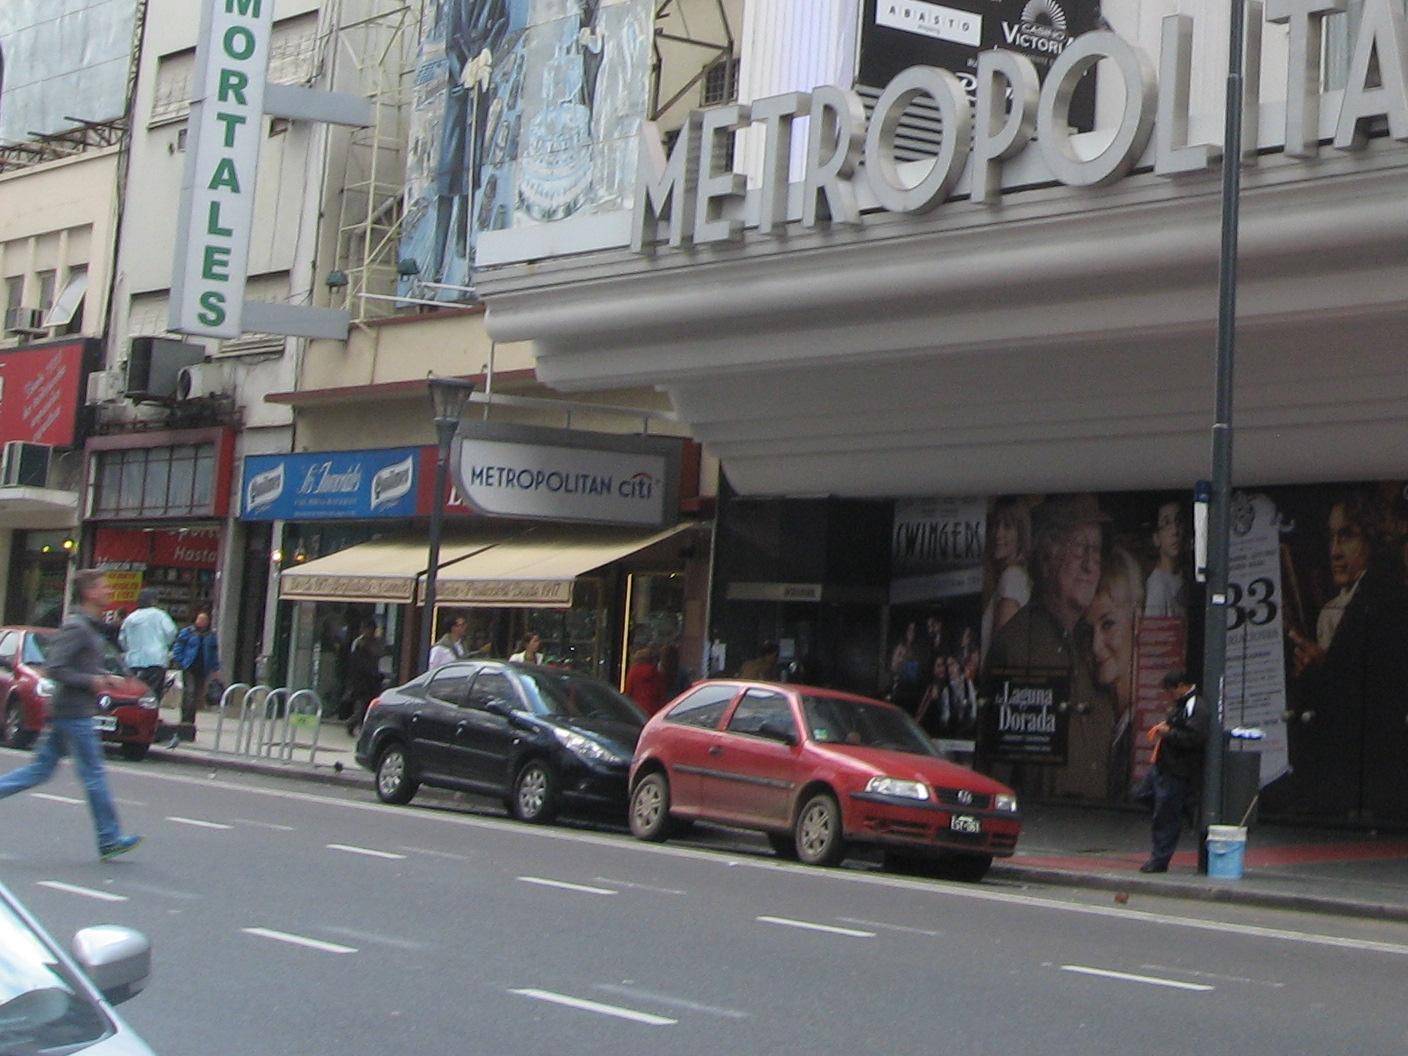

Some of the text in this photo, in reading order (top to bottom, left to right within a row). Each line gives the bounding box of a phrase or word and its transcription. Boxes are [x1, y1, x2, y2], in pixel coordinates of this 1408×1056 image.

[887, 4, 973, 33] ABASTO
[1021, 22, 1066, 41] CASINO
[470, 464, 653, 500] METROPOLITAN citi
[1002, 680, 1053, 711] Laguna
[999, 704, 1057, 733] Dorada
